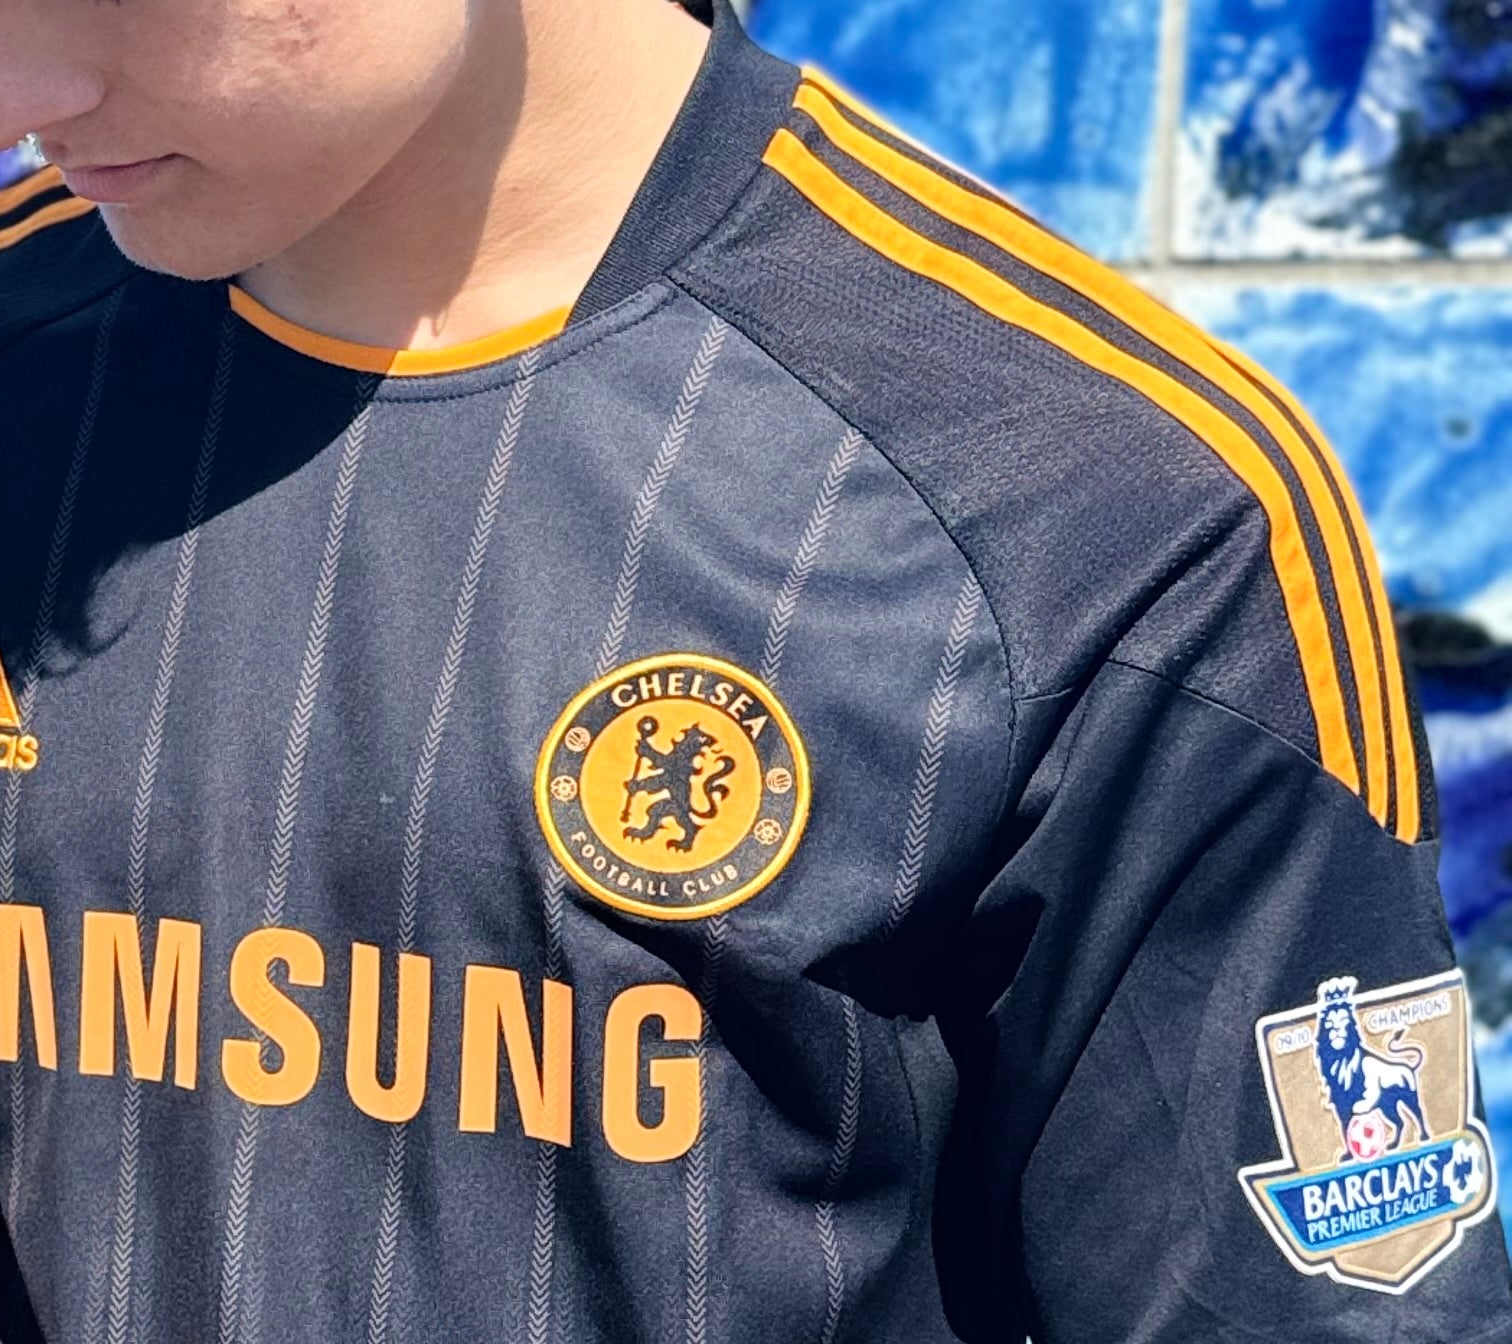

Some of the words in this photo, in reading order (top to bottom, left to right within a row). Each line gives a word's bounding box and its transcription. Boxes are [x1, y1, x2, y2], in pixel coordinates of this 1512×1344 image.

[610, 672, 769, 741] CHELSEA
[571, 830, 670, 897] FOOTBALL
[682, 863, 739, 897] CLUB
[1369, 995, 1449, 1029] CHAMPIONS
[1302, 1154, 1439, 1221] BARCLAYS
[1307, 1204, 1383, 1244] PREMIER
[1384, 1187, 1439, 1223] LEAGUE
